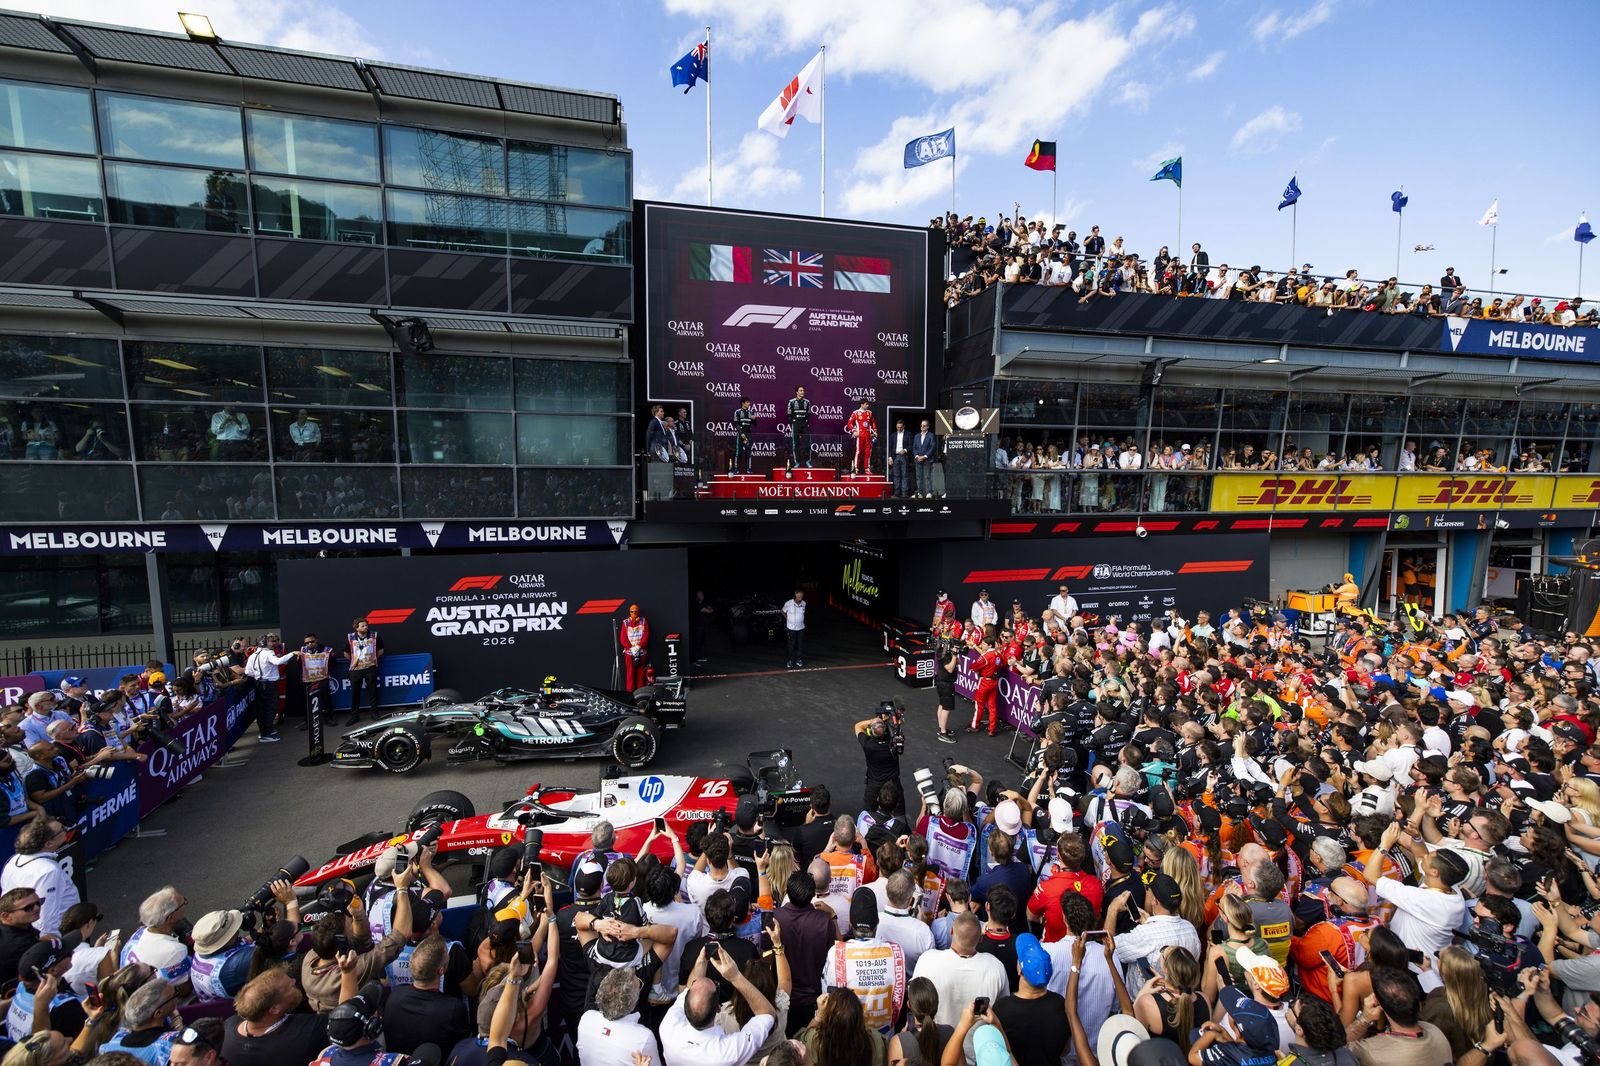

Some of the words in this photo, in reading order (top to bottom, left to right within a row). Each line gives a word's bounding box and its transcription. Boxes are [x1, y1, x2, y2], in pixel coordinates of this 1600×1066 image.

[809, 312, 862, 322] AUSTRALIAN
[668, 320, 704, 331] QATAR
[809, 320, 838, 328] GRAND
[877, 332, 908, 342] QATAR
[1488, 329, 1586, 353] MELBOURNE
[706, 342, 741, 352] QATAR
[776, 346, 810, 356] QATAR
[844, 350, 876, 360] QATAR
[668, 360, 704, 371] QATAR
[742, 364, 776, 374] QATAR
[810, 366, 843, 377] QATAR
[877, 370, 908, 380] QATAR
[706, 382, 741, 392] QATAR
[844, 387, 876, 397] QATAR
[748, 404, 776, 412] ATAR
[810, 405, 843, 416] QATAR
[706, 422, 738, 432] QATA
[751, 442, 776, 450] ATAR
[810, 443, 843, 453] QATAR
[806, 472, 813, 480] 1
[758, 484, 792, 496] MOËT
[794, 486, 802, 496] &
[804, 486, 860, 496] CHANDON
[1255, 480, 1355, 504] DHL
[1433, 480, 1518, 504] DHL
[262, 528, 397, 545] MELBOURNE
[468, 526, 587, 542] MELBOURNE
[10, 530, 167, 550] MELBOURNE
[510, 574, 544, 585] QATAR
[426, 601, 568, 622] AUSTRALIAN
[431, 620, 510, 636] GRAND
[513, 617, 563, 632] PRIX
[483, 637, 515, 646] 2026
[668, 644, 677, 656] 1
[897, 656, 907, 678] 3
[385, 670, 430, 687] FERMÉ
[312, 696, 319, 713] 2
[522, 736, 574, 745] PETRONAS
[166, 739, 218, 788] AIRWAYS
[642, 777, 662, 803] hp
[698, 780, 730, 798] 16
[92, 778, 136, 828] FERMÉ
[431, 804, 458, 812] ZERO
[686, 810, 715, 820] UniCre
[1264, 925, 1288, 936] PIRELLI
[892, 944, 903, 1005] MELBOURNE
